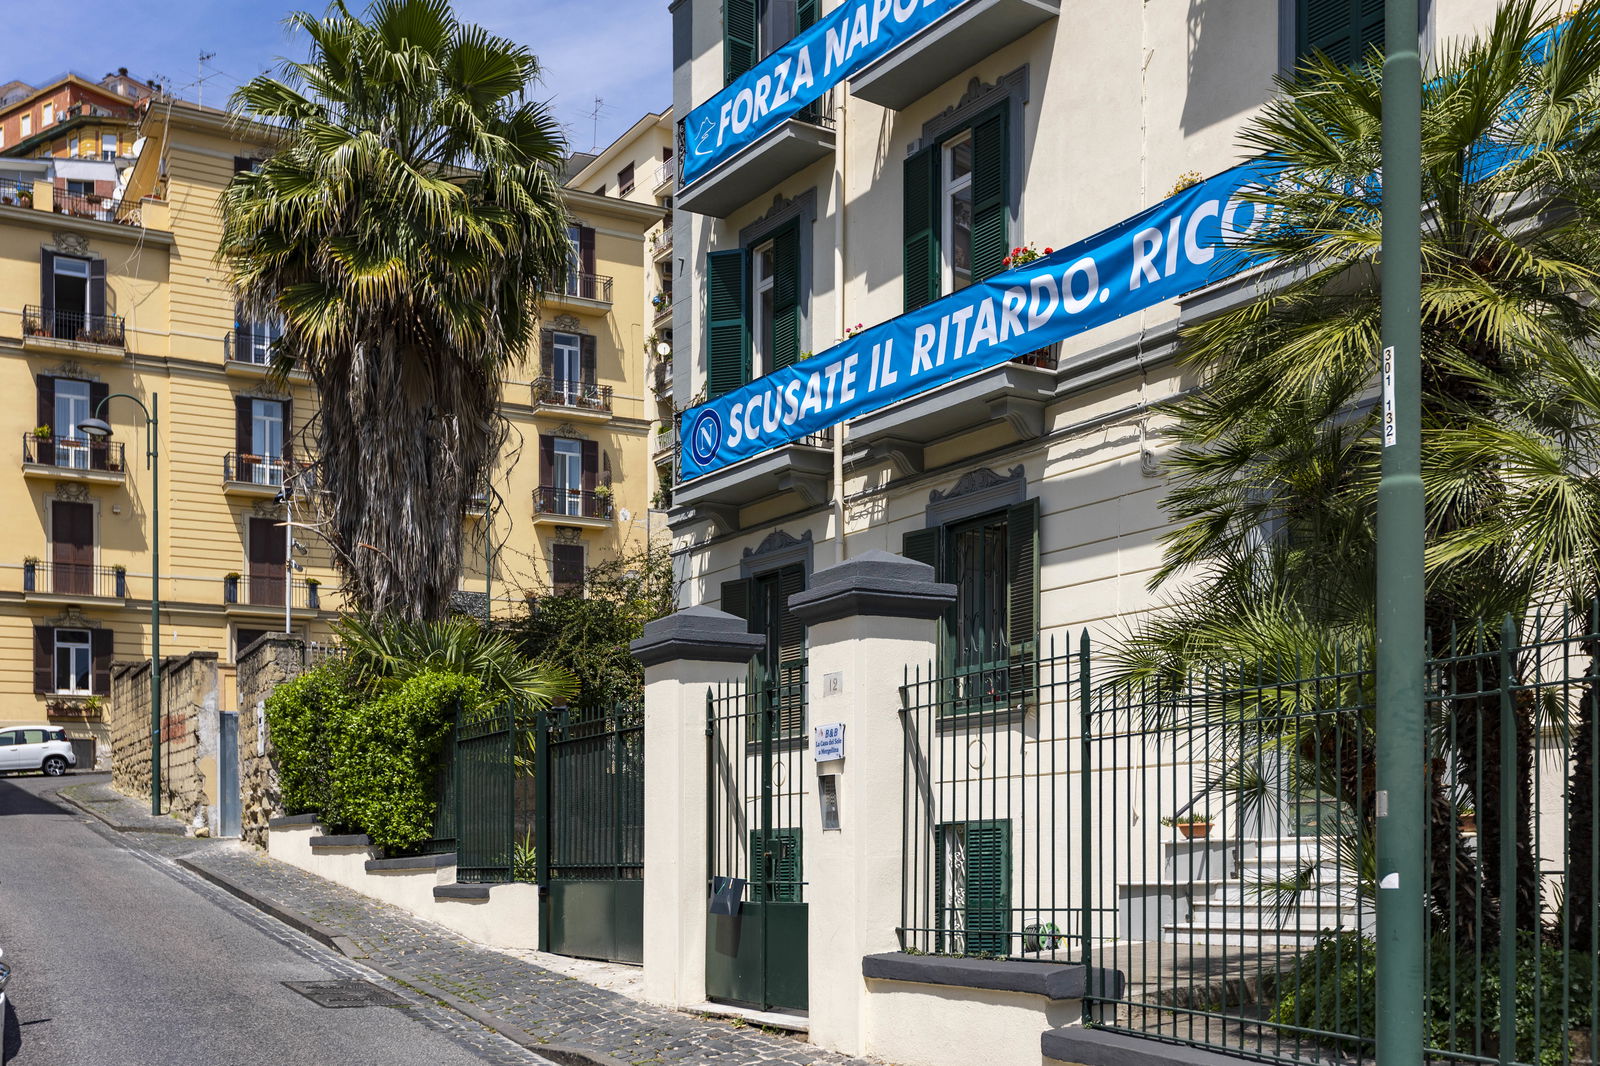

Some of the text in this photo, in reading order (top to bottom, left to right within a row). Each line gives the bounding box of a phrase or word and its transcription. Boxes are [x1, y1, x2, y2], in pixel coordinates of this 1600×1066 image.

[717, 0, 936, 147] FORZA NAP
[727, 353, 859, 447] SCUSATE
[868, 338, 898, 393] IL
[910, 257, 1110, 376] RITARDO.
[700, 423, 713, 451] N
[829, 678, 838, 691] 12
[825, 728, 838, 738] B&B
